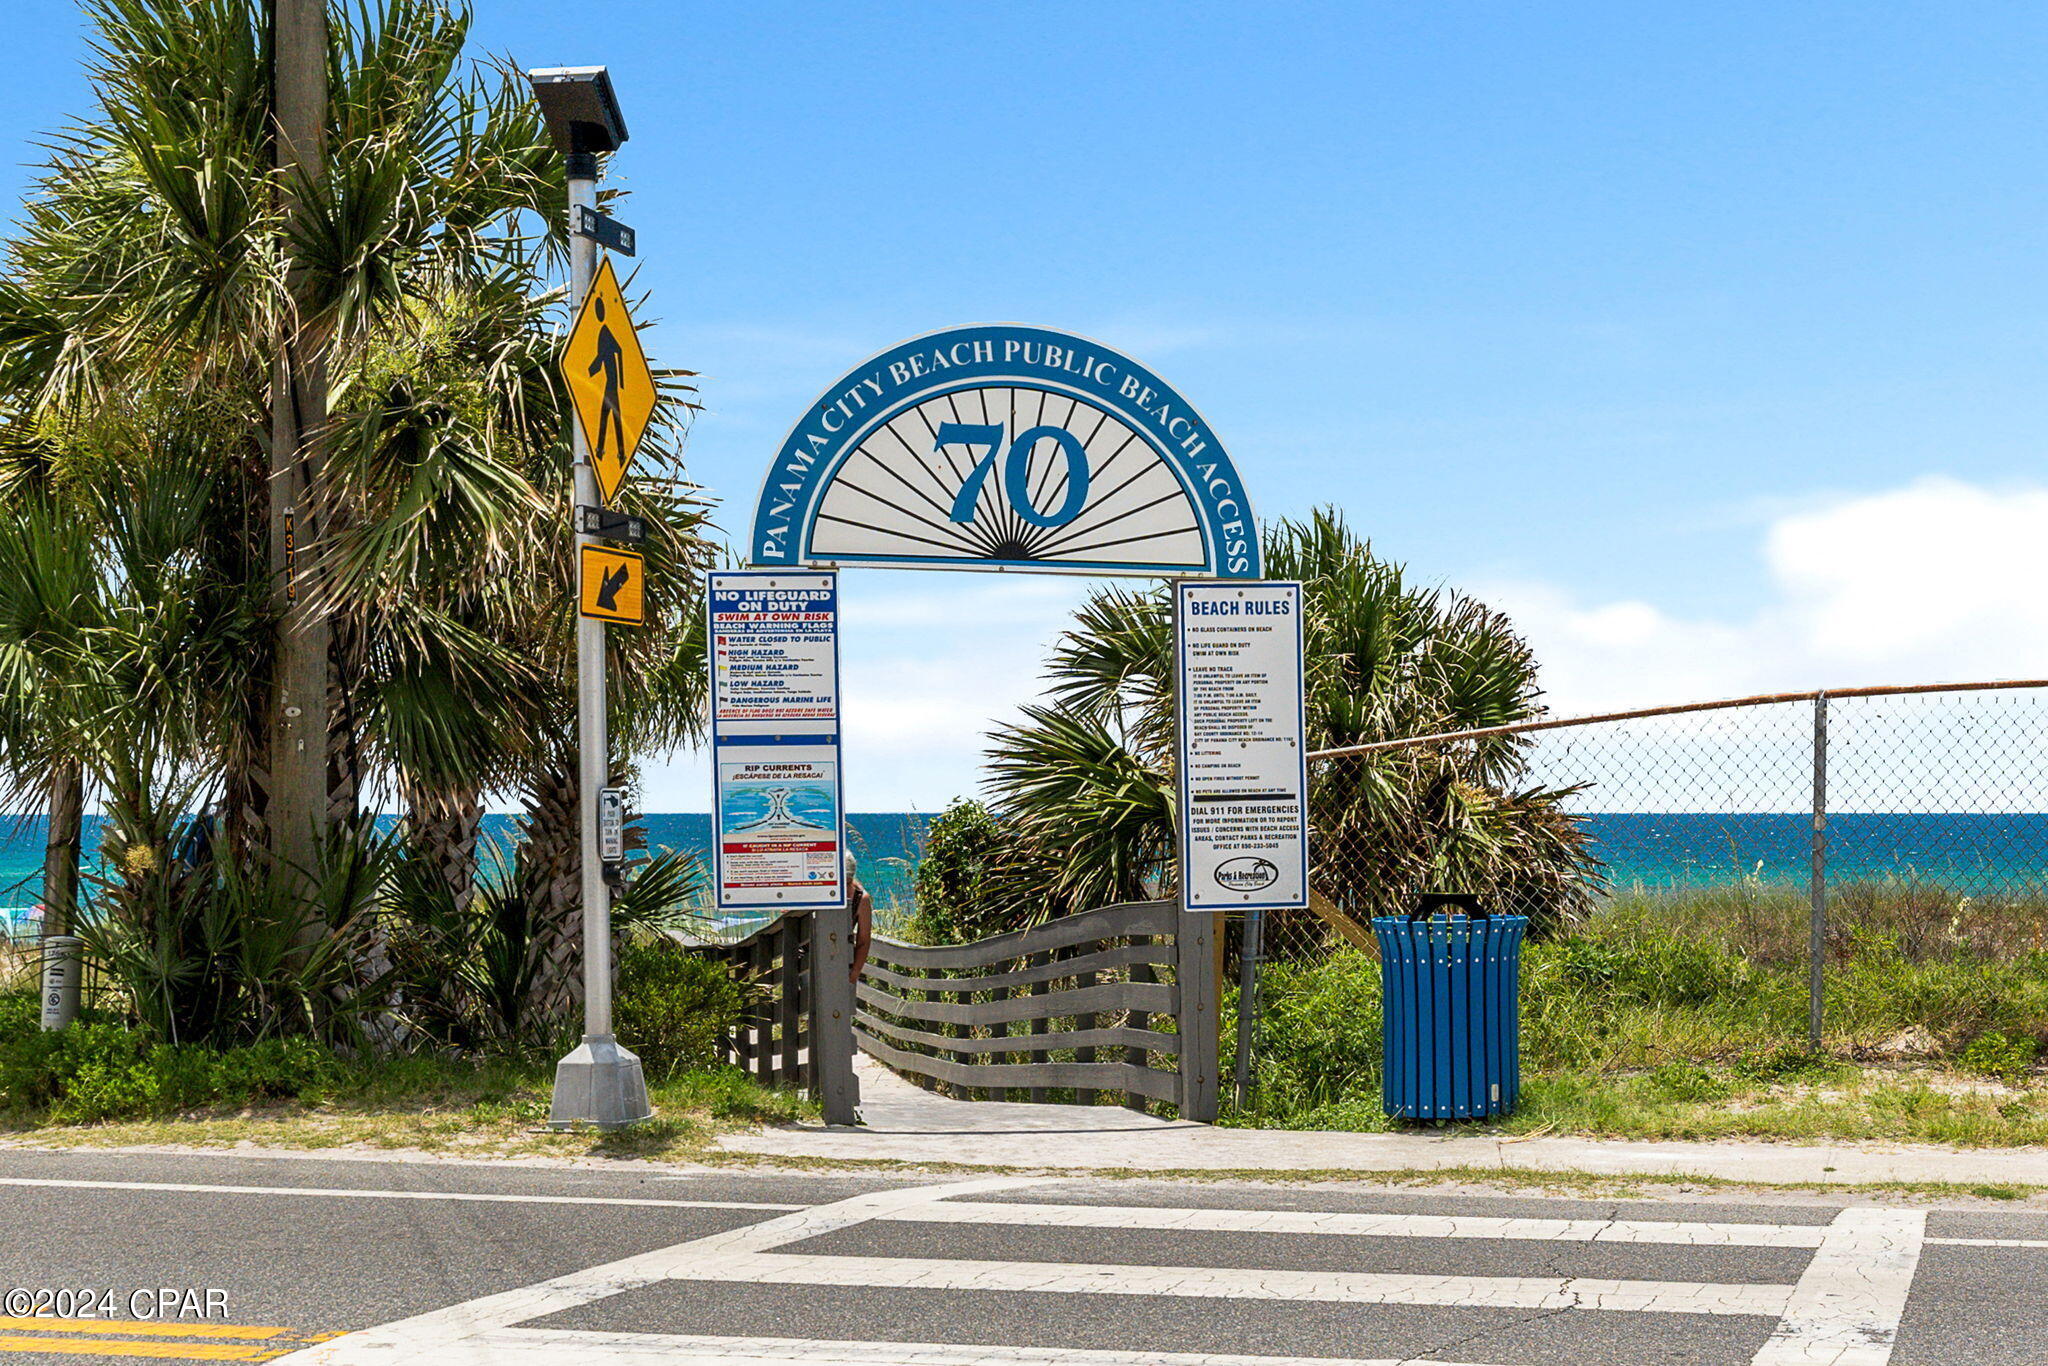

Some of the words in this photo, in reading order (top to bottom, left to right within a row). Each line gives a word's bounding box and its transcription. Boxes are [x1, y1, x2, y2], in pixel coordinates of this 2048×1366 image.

[763, 432, 828, 558] PANAMA
[822, 372, 884, 432] CITY
[888, 340, 994, 386] BEACH
[1004, 340, 1116, 386] PUBLIC
[1118, 374, 1206, 458] BEACH
[1196, 462, 1249, 574] ACCESS
[934, 420, 1090, 528] 70
[284, 516, 296, 598] K3719
[716, 592, 739, 601] NO
[745, 591, 830, 600] LIFEGUARD
[738, 602, 762, 611] ON
[768, 602, 808, 611] DUTY
[1192, 601, 1239, 616] BEACH
[1245, 600, 1290, 615] RULES
[1191, 807, 1208, 815] DIAL
[1210, 807, 1224, 815] 911
[1227, 807, 1242, 815] FOR
[1245, 806, 1299, 814] EMERGENCIES
